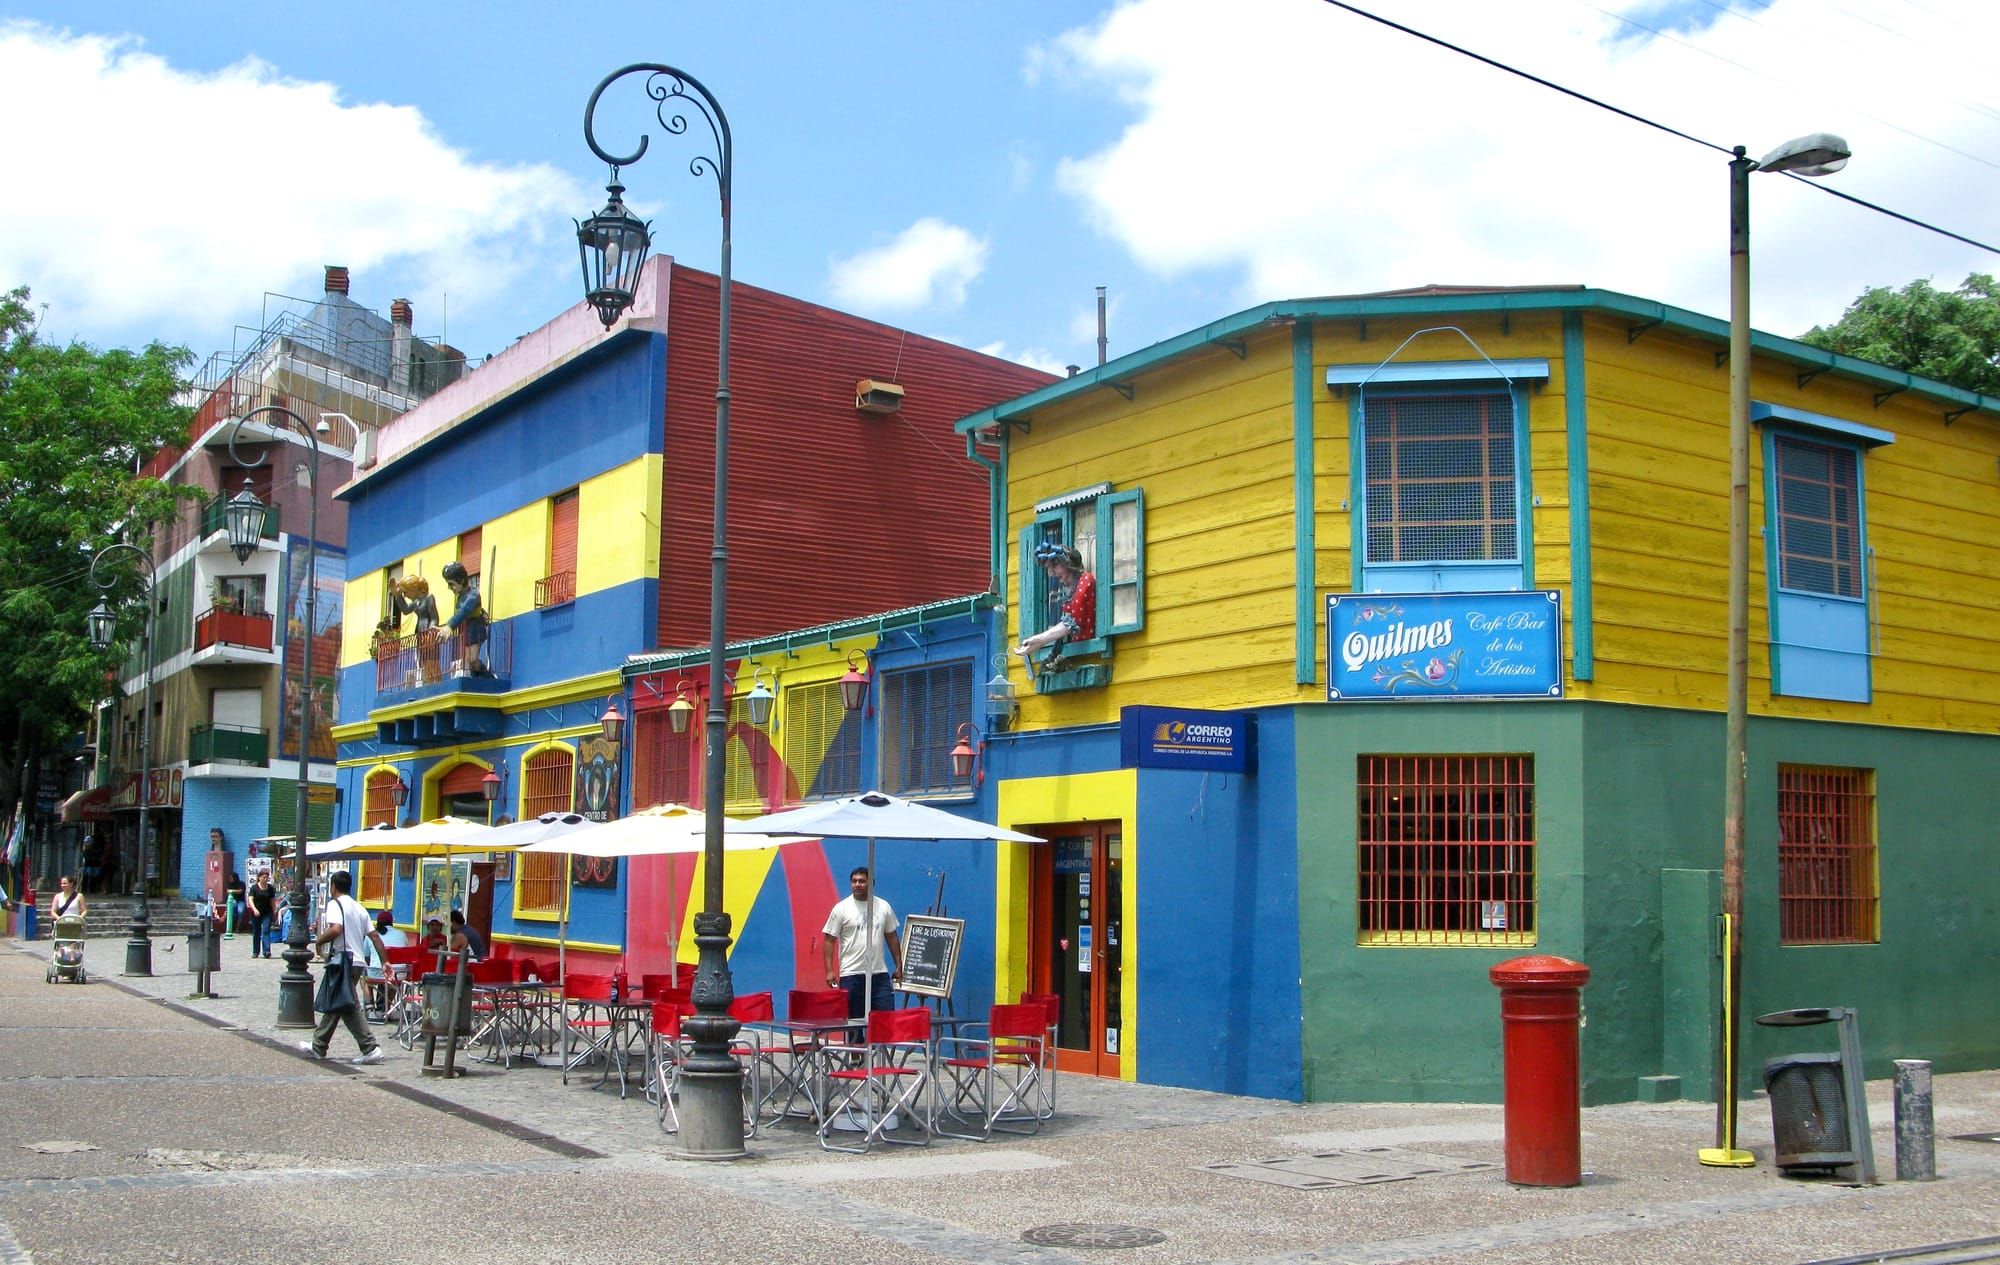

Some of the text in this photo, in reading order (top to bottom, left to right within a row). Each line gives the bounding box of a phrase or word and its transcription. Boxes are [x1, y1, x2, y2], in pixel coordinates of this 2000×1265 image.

[1466, 610, 1547, 636] Café Bar
[1342, 618, 1454, 673] Quilmes
[1486, 637, 1523, 652] de los
[1475, 656, 1537, 676] Artistas
[1187, 725, 1232, 737] CORREO
